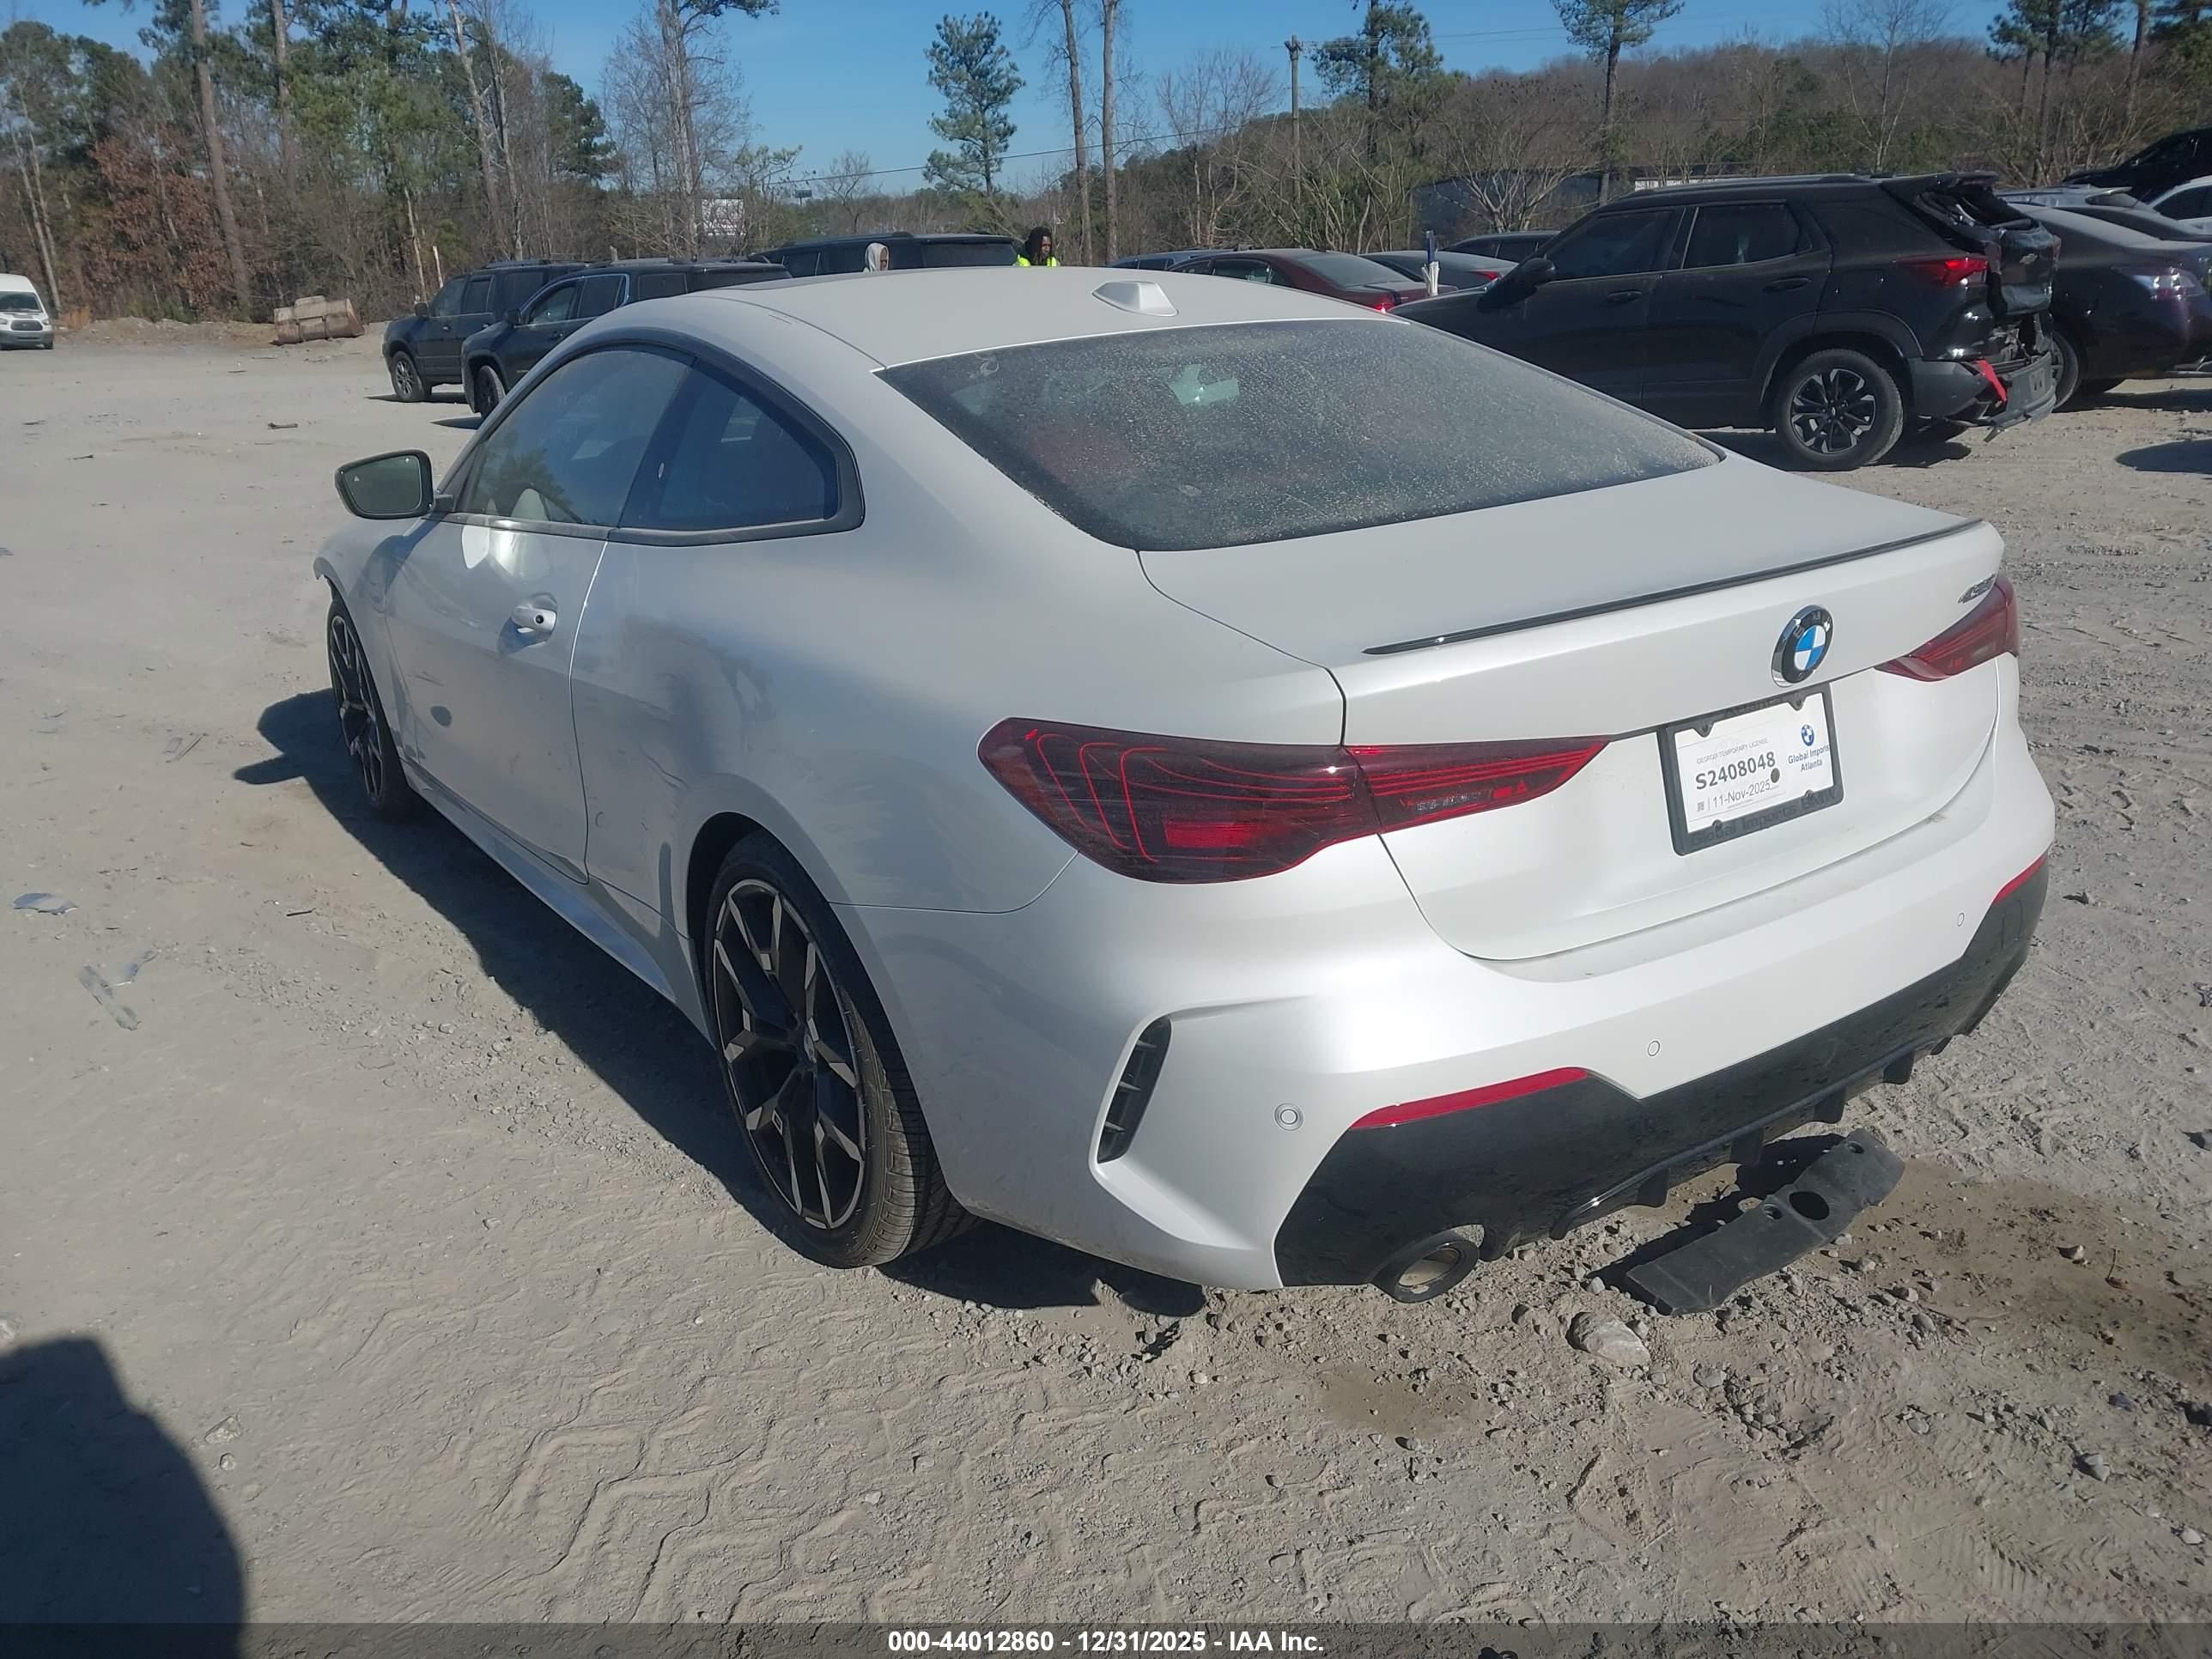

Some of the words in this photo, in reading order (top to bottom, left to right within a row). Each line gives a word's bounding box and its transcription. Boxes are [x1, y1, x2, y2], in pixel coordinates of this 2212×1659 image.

[1788, 749, 1809, 764] Global
[1800, 758, 1823, 773] Atlanta
[1695, 751, 1776, 790] S2408048
[1712, 779, 1771, 808] 11-Nov-2025
[1742, 804, 1797, 830] Imports
